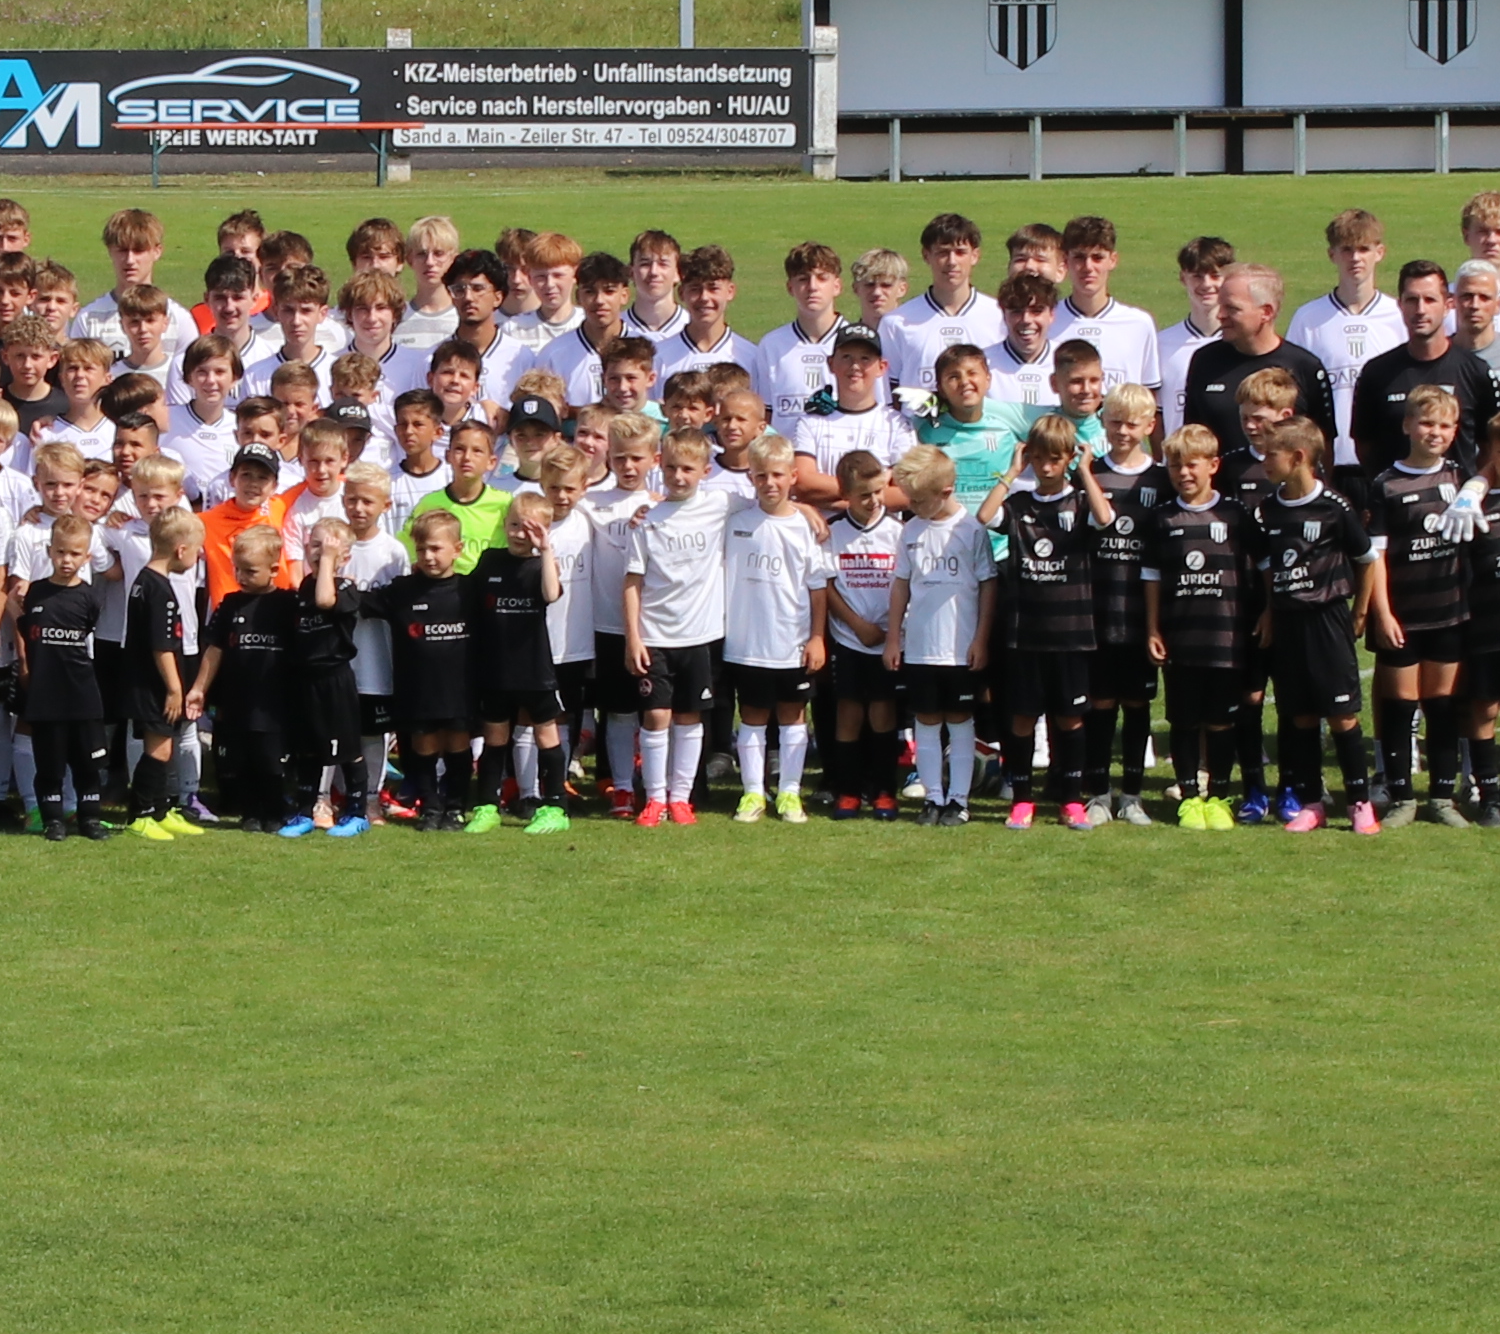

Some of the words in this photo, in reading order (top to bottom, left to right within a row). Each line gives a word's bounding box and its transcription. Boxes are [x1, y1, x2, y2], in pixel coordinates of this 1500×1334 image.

[405, 64, 577, 83] KfZ-Meisterbetrieb
[594, 63, 791, 87] Unfallinstandsetzung
[117, 99, 360, 122] SERVICE
[407, 96, 476, 115] Service
[482, 96, 527, 115] nach
[533, 97, 711, 119] Herstellervorgaben
[728, 96, 790, 115] HU/AU
[206, 129, 318, 145] WERKSTATT
[400, 128, 442, 143] Sand
[447, 133, 461, 143] a.
[466, 128, 505, 143] Main
[520, 128, 568, 143] Zeiler
[571, 128, 599, 143] Str.
[605, 128, 622, 143] 47
[639, 128, 663, 143] Tel
[667, 127, 786, 144] 09524/3048707
